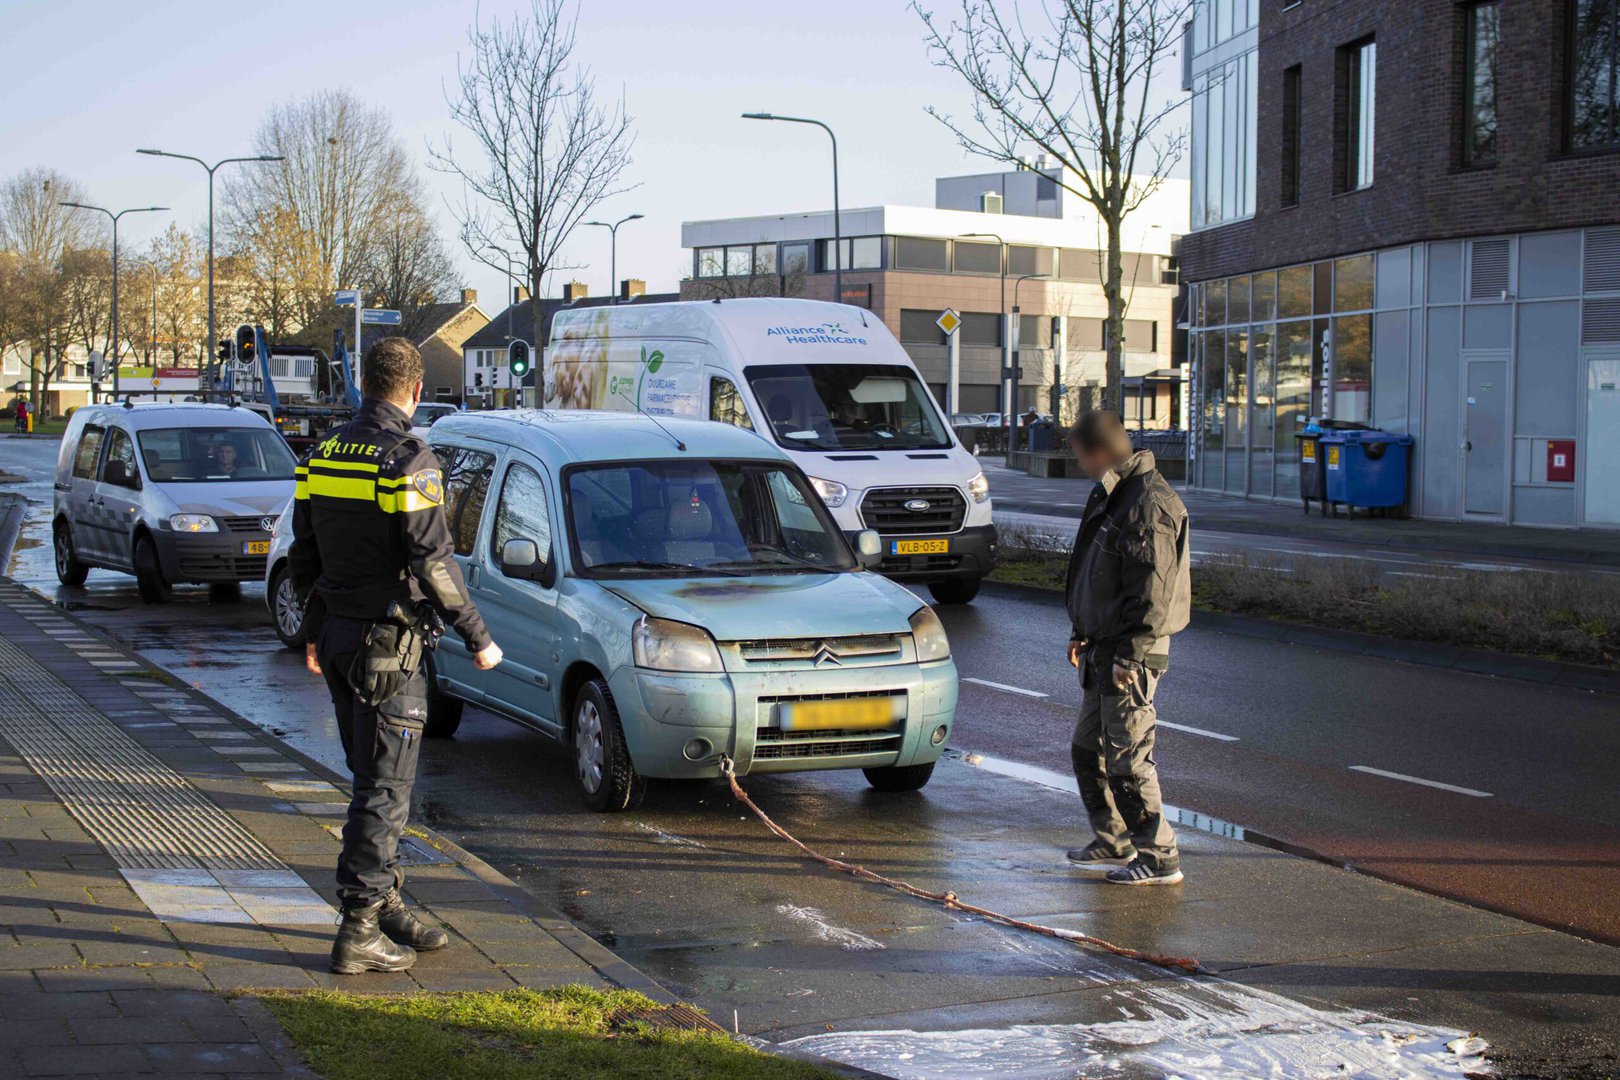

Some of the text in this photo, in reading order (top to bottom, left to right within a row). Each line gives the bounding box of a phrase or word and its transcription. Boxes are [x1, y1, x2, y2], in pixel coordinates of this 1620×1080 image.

[767, 326, 826, 336] Alliance
[786, 335, 868, 345] Healthcare
[1320, 329, 1329, 418] mino's
[648, 378, 676, 389] DUURZAME
[318, 434, 377, 458] POLITIE
[251, 543, 271, 552] 48-
[900, 541, 945, 552] VLB-05-Z
